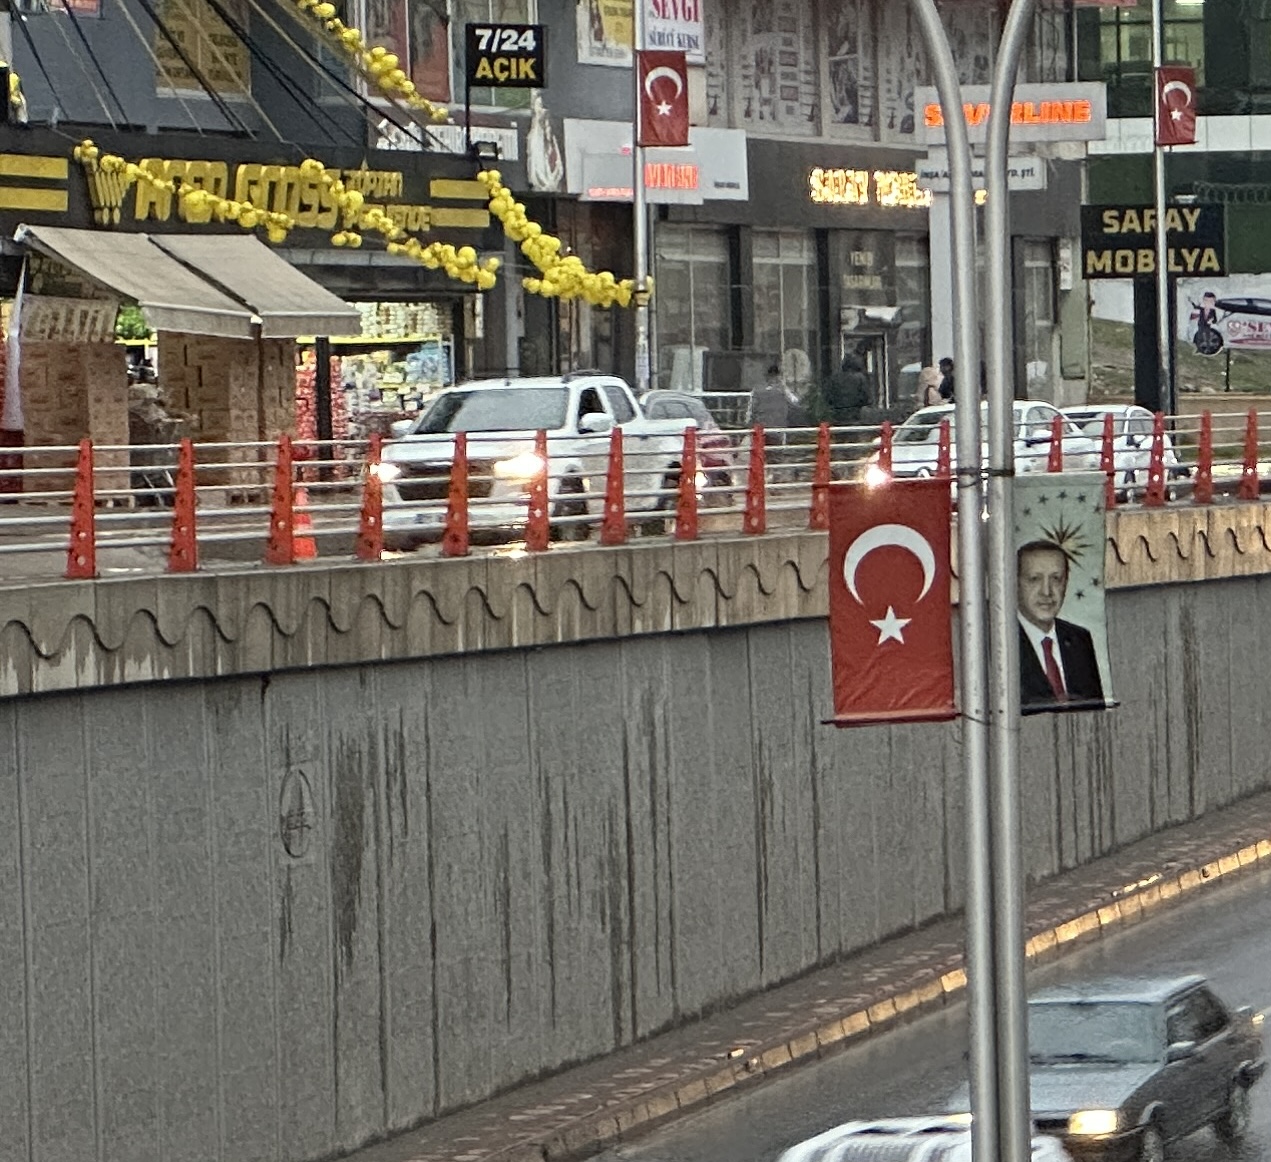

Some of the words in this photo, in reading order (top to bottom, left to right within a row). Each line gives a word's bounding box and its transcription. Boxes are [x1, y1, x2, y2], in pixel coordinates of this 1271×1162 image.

[475, 28, 536, 51] 7/24
[474, 57, 536, 82] AÇIK
[1102, 208, 1201, 234] SARAY
[1086, 248, 1221, 274] MOBLYA
